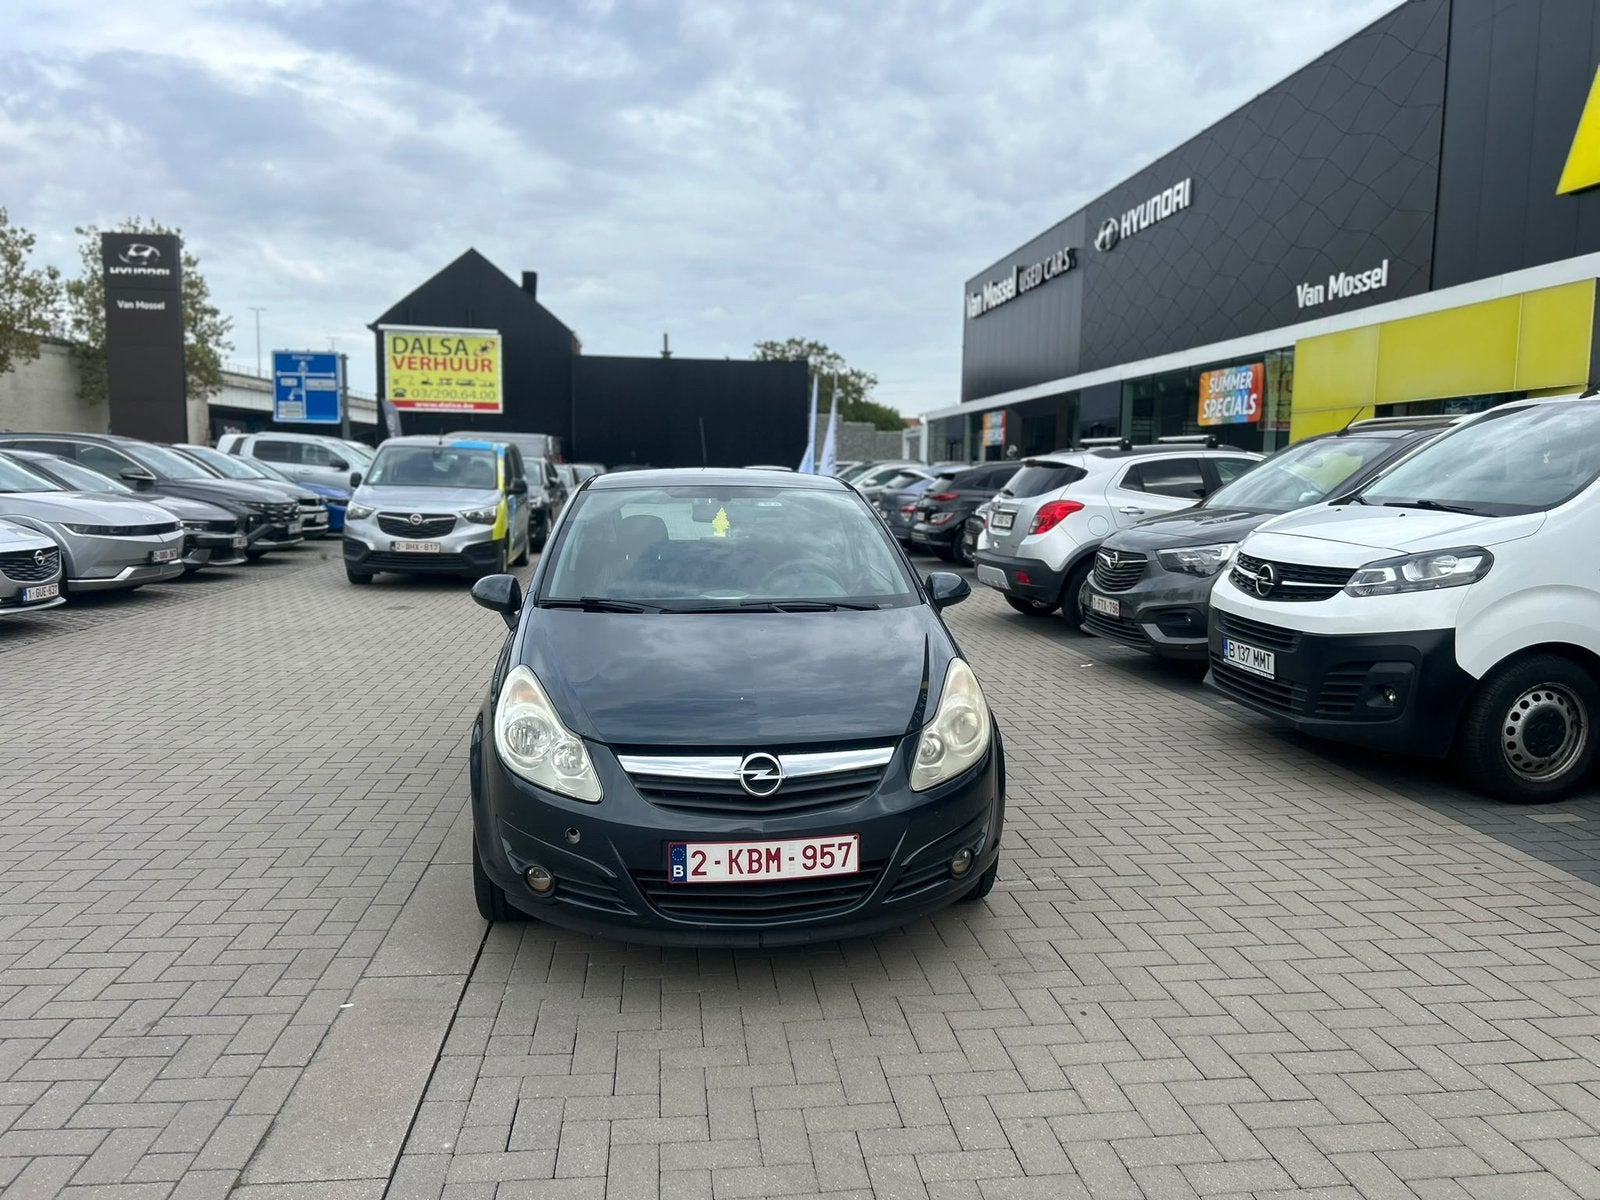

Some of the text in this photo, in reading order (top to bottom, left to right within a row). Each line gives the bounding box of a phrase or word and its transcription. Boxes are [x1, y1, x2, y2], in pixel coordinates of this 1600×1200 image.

[1121, 178, 1191, 239] HYUNDAI
[982, 264, 1018, 313] Mossel
[1019, 261, 1043, 294] USED
[1043, 246, 1071, 280] CARS
[1296, 259, 1389, 309] Van Mossel
[117, 300, 134, 309] Van
[392, 336, 469, 356] DALSA
[392, 355, 493, 373] VERHUUR
[1208, 371, 1254, 394] SUMMER
[1202, 393, 1258, 419] SPECIALS
[1229, 642, 1271, 671] B 137 MMT
[673, 865, 684, 877] B
[690, 842, 852, 876] 2-KBM-957
